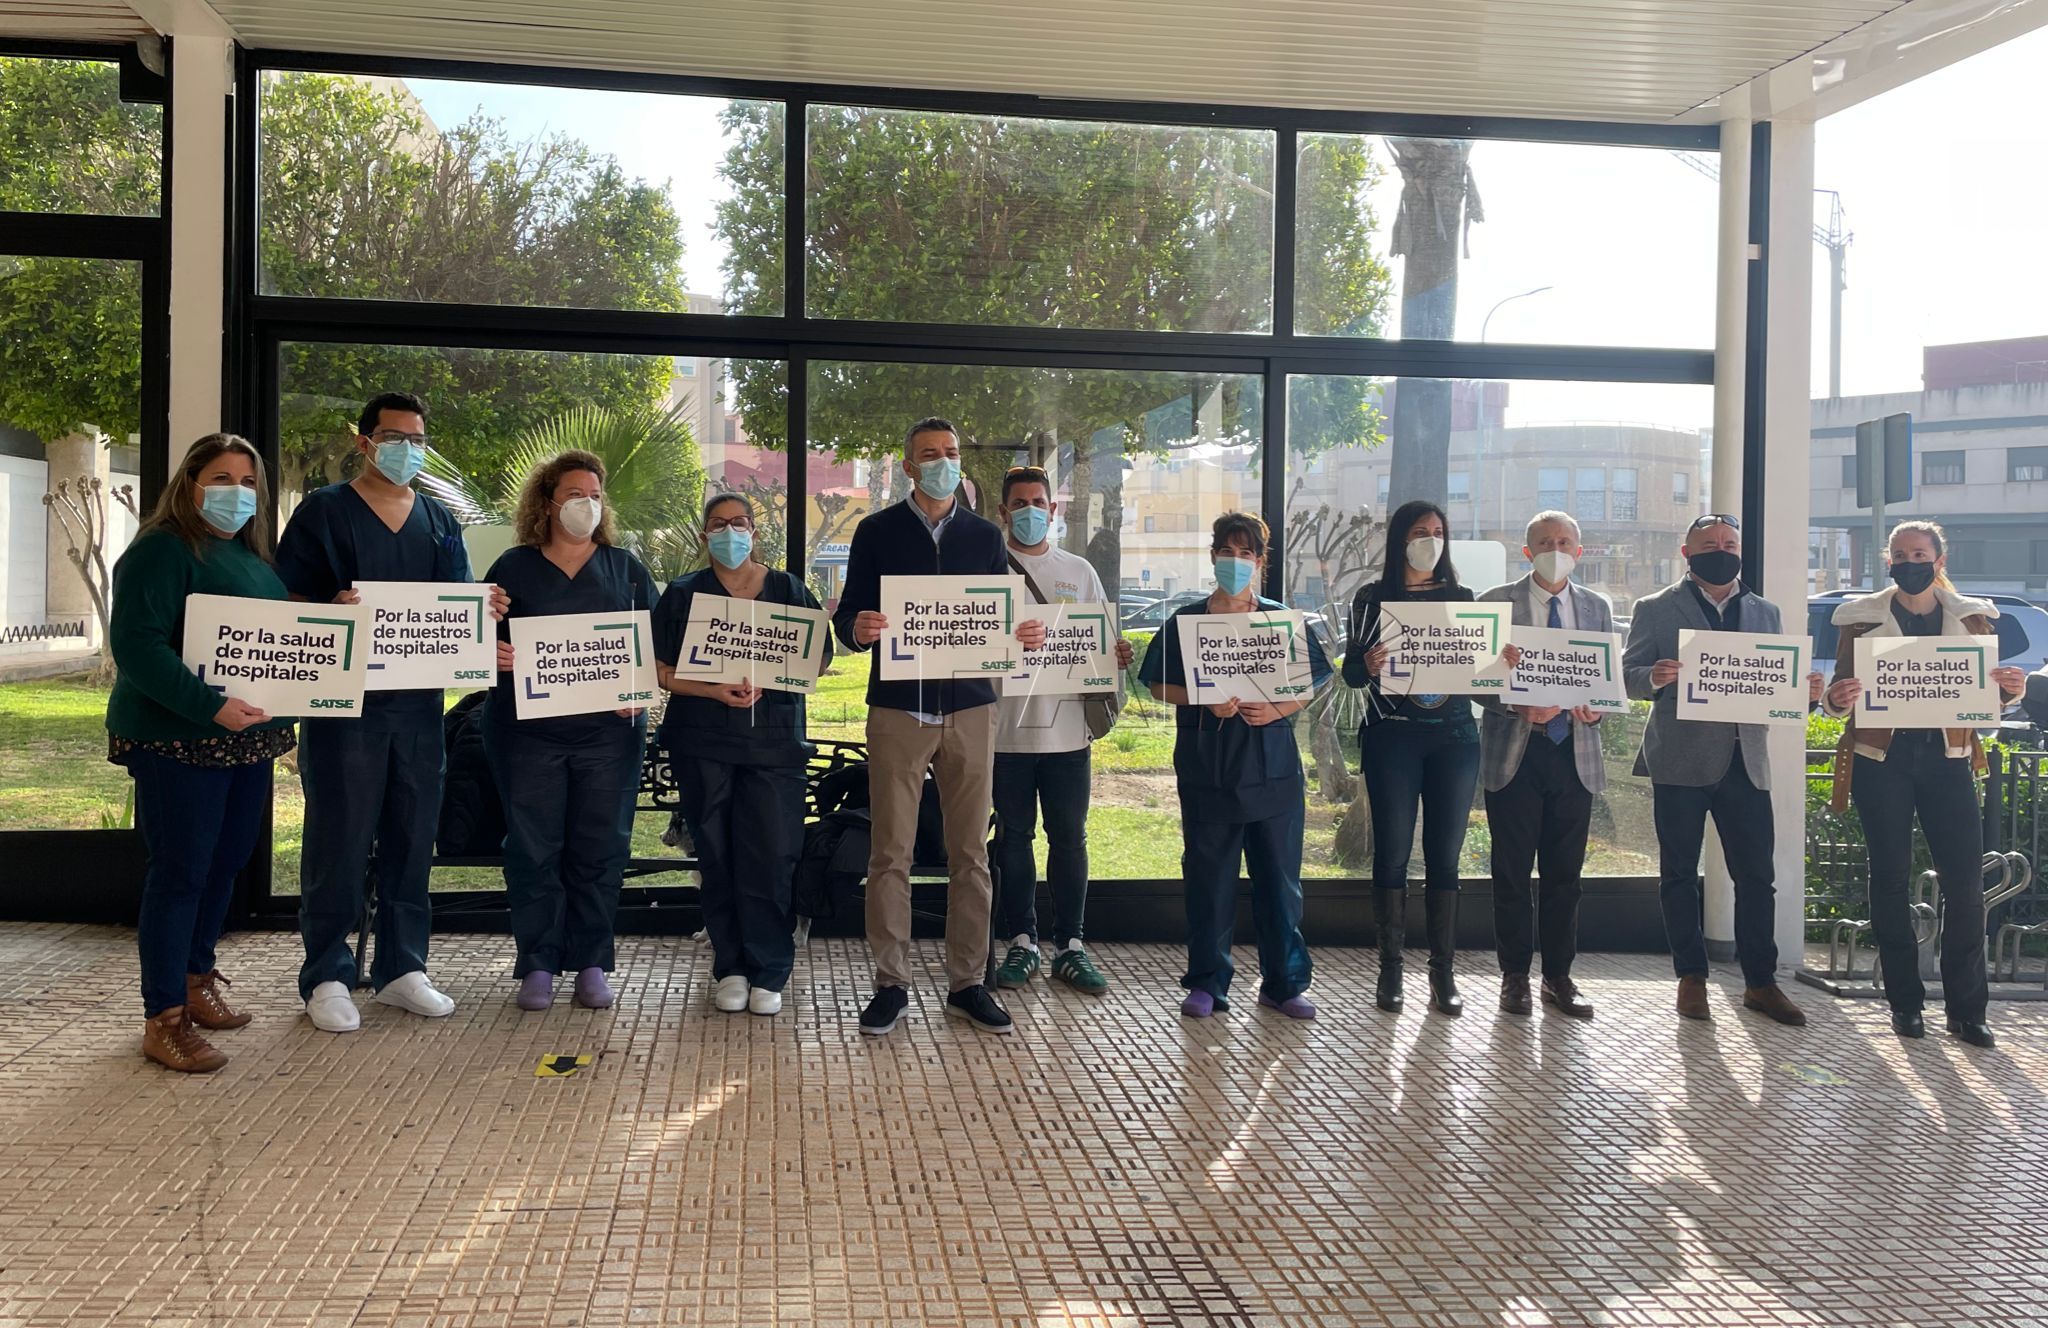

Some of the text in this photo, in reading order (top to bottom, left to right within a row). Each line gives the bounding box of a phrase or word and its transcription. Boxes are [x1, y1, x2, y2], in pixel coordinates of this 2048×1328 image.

[905, 602, 996, 615] Por la salud
[376, 609, 468, 623] Por la salud
[374, 624, 471, 638] de nuestros
[710, 618, 798, 641] Por la salud
[904, 617, 1000, 631] de nuestros
[1402, 625, 1484, 637] Por la salud
[218, 626, 334, 648] Por la salud
[1045, 626, 1093, 638] la salud
[536, 636, 626, 654] Por la salud
[707, 632, 798, 653] de nuestros
[904, 632, 986, 648] hospitales
[1041, 640, 1096, 651] nuestros
[1200, 634, 1280, 648] Por la salud
[1401, 640, 1486, 651] de nuestros
[216, 643, 336, 665] de nuestros
[374, 640, 458, 657] hospitales
[704, 644, 783, 663] hospitales
[1202, 649, 1285, 661] de nuestros
[537, 653, 630, 669] de nuestros
[1401, 652, 1475, 667] hospitales
[1543, 649, 1555, 660] la
[1558, 652, 1597, 664] salud
[1700, 653, 1784, 669] Por la salud
[214, 660, 318, 682] hospitales
[982, 659, 1016, 669] SATSE
[1203, 662, 1275, 677] hospitales
[1516, 660, 1600, 677] de nuestros
[1877, 659, 1969, 671] Por la salud
[454, 670, 490, 679] SATSE
[538, 667, 620, 686] hospitales
[1516, 672, 1591, 687] hospitales
[1699, 666, 1786, 682] de nuestros
[1877, 673, 1973, 685] de nuestros
[774, 676, 810, 687] SATSE
[1471, 679, 1504, 687] SATSE
[1699, 680, 1774, 696] hospitales
[618, 691, 653, 701] SATSE
[1274, 686, 1306, 694] SATSE
[1877, 686, 1960, 700] hospitales
[310, 699, 354, 708] SATSE
[1590, 699, 1622, 707] SATSE
[1769, 710, 1802, 719] SATSE
